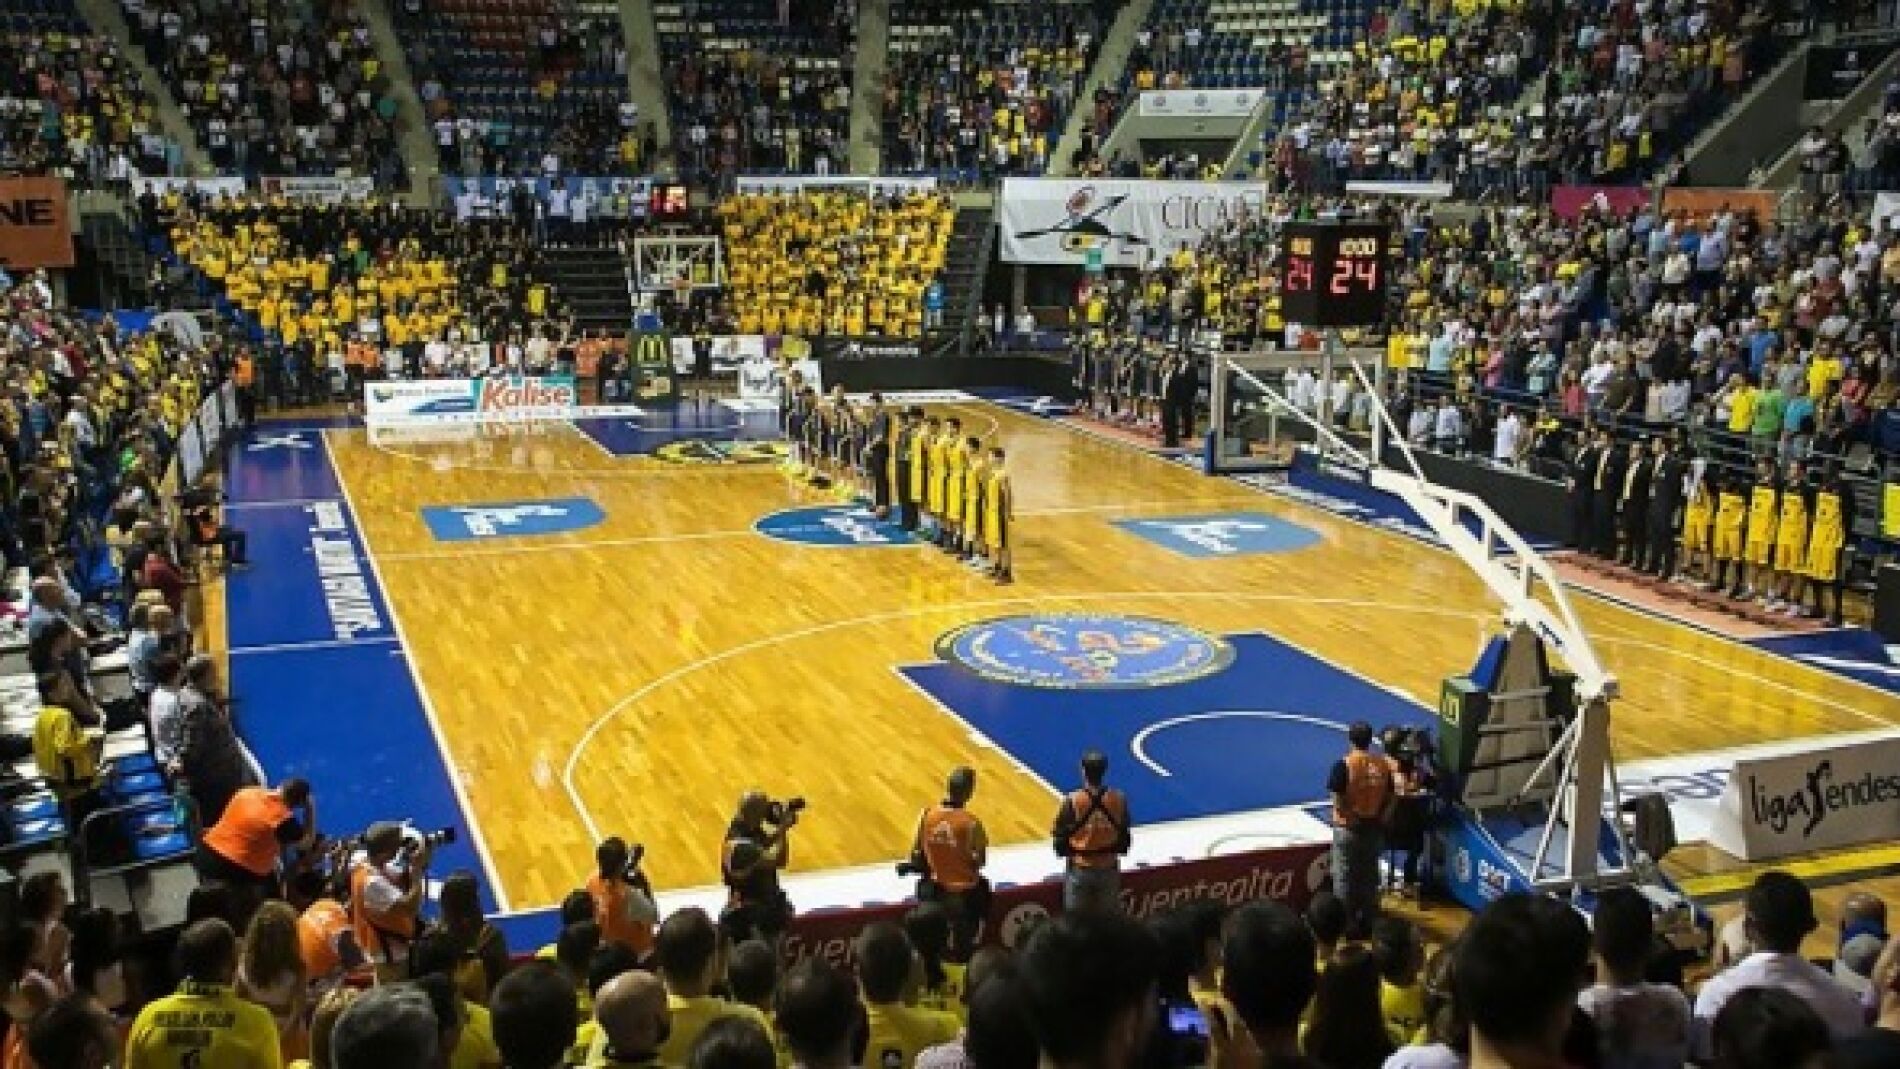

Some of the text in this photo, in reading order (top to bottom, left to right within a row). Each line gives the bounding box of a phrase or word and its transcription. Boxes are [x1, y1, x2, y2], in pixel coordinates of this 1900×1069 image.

[1287, 257, 1313, 290] 24
[1330, 260, 1376, 294] 24
[482, 378, 571, 411] Kalise
